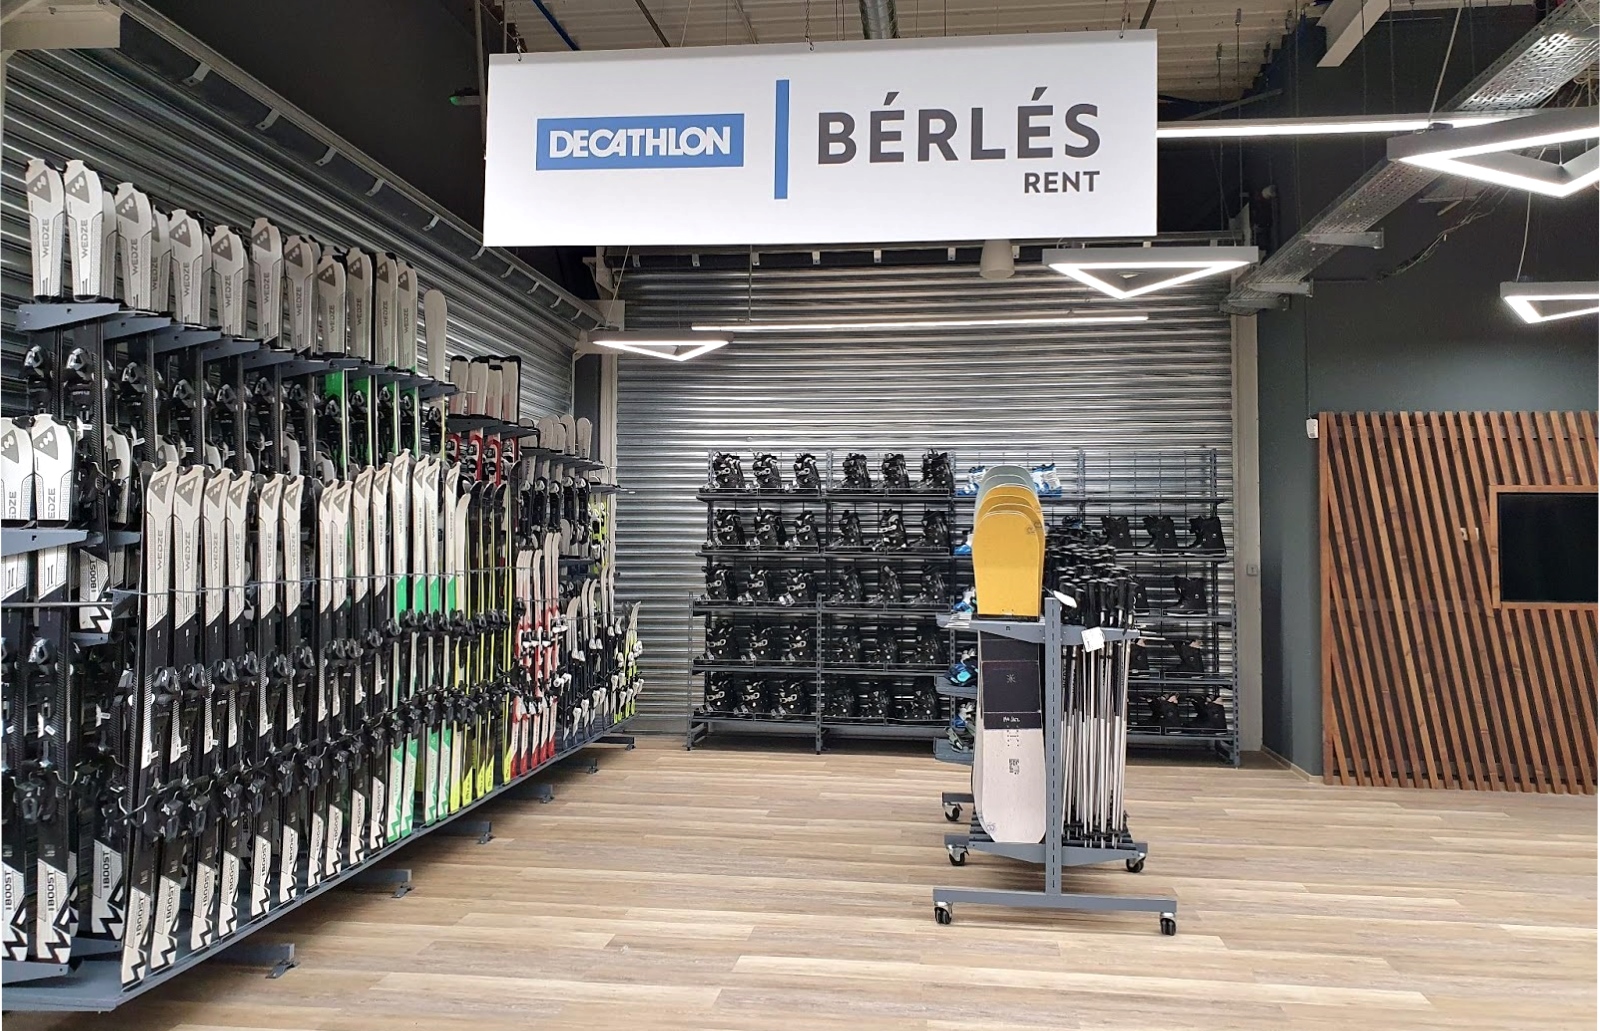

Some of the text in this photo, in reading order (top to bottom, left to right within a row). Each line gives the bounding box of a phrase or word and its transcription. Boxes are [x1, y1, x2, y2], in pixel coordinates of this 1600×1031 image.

[818, 86, 1100, 165] BÉRLÉS
[549, 126, 731, 159] DECATHLON
[1024, 170, 1100, 193] RENT
[9, 491, 17, 519] EDZE
